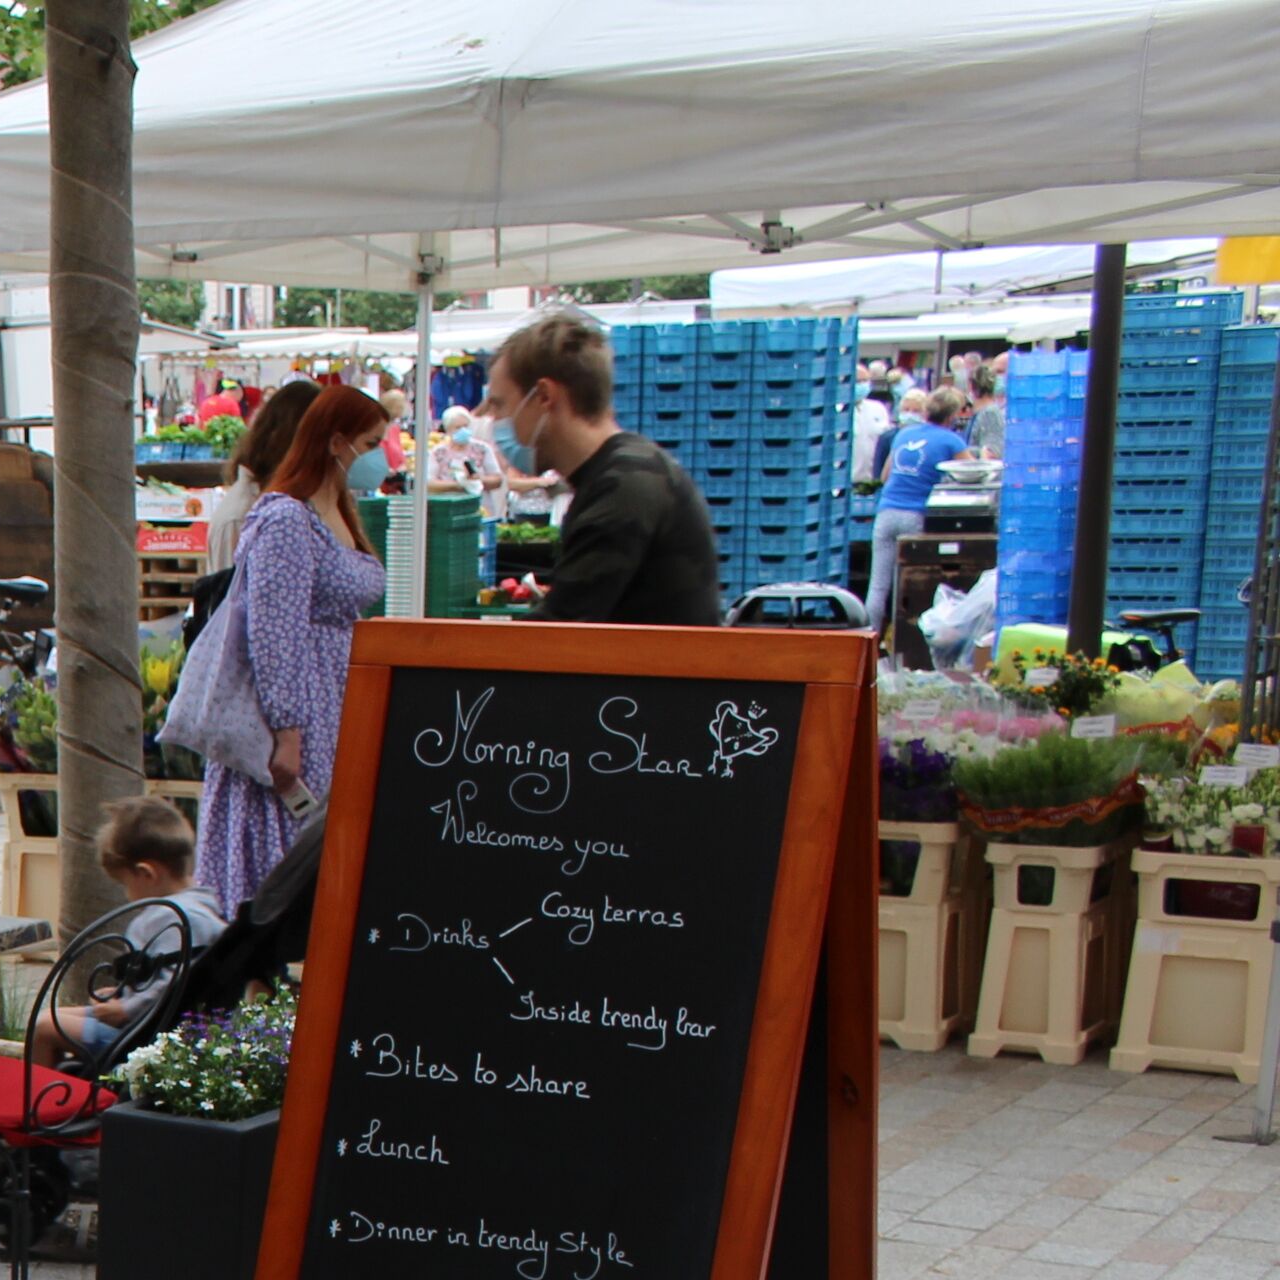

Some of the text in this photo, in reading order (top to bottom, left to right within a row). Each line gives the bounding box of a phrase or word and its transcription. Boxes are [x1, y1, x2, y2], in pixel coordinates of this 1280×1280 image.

[414, 686, 570, 814] Morning
[430, 780, 630, 876] Welcomes you
[389, 913, 490, 952] Drinks
[541, 891, 685, 945] Cozy terras
[510, 991, 717, 1051] Inside trendy bar
[366, 1033, 591, 1099] Bites to share
[356, 1118, 450, 1165] Lunch
[348, 1211, 438, 1243] Dinner
[447, 1227, 470, 1247] in
[478, 1218, 548, 1280] trendy
